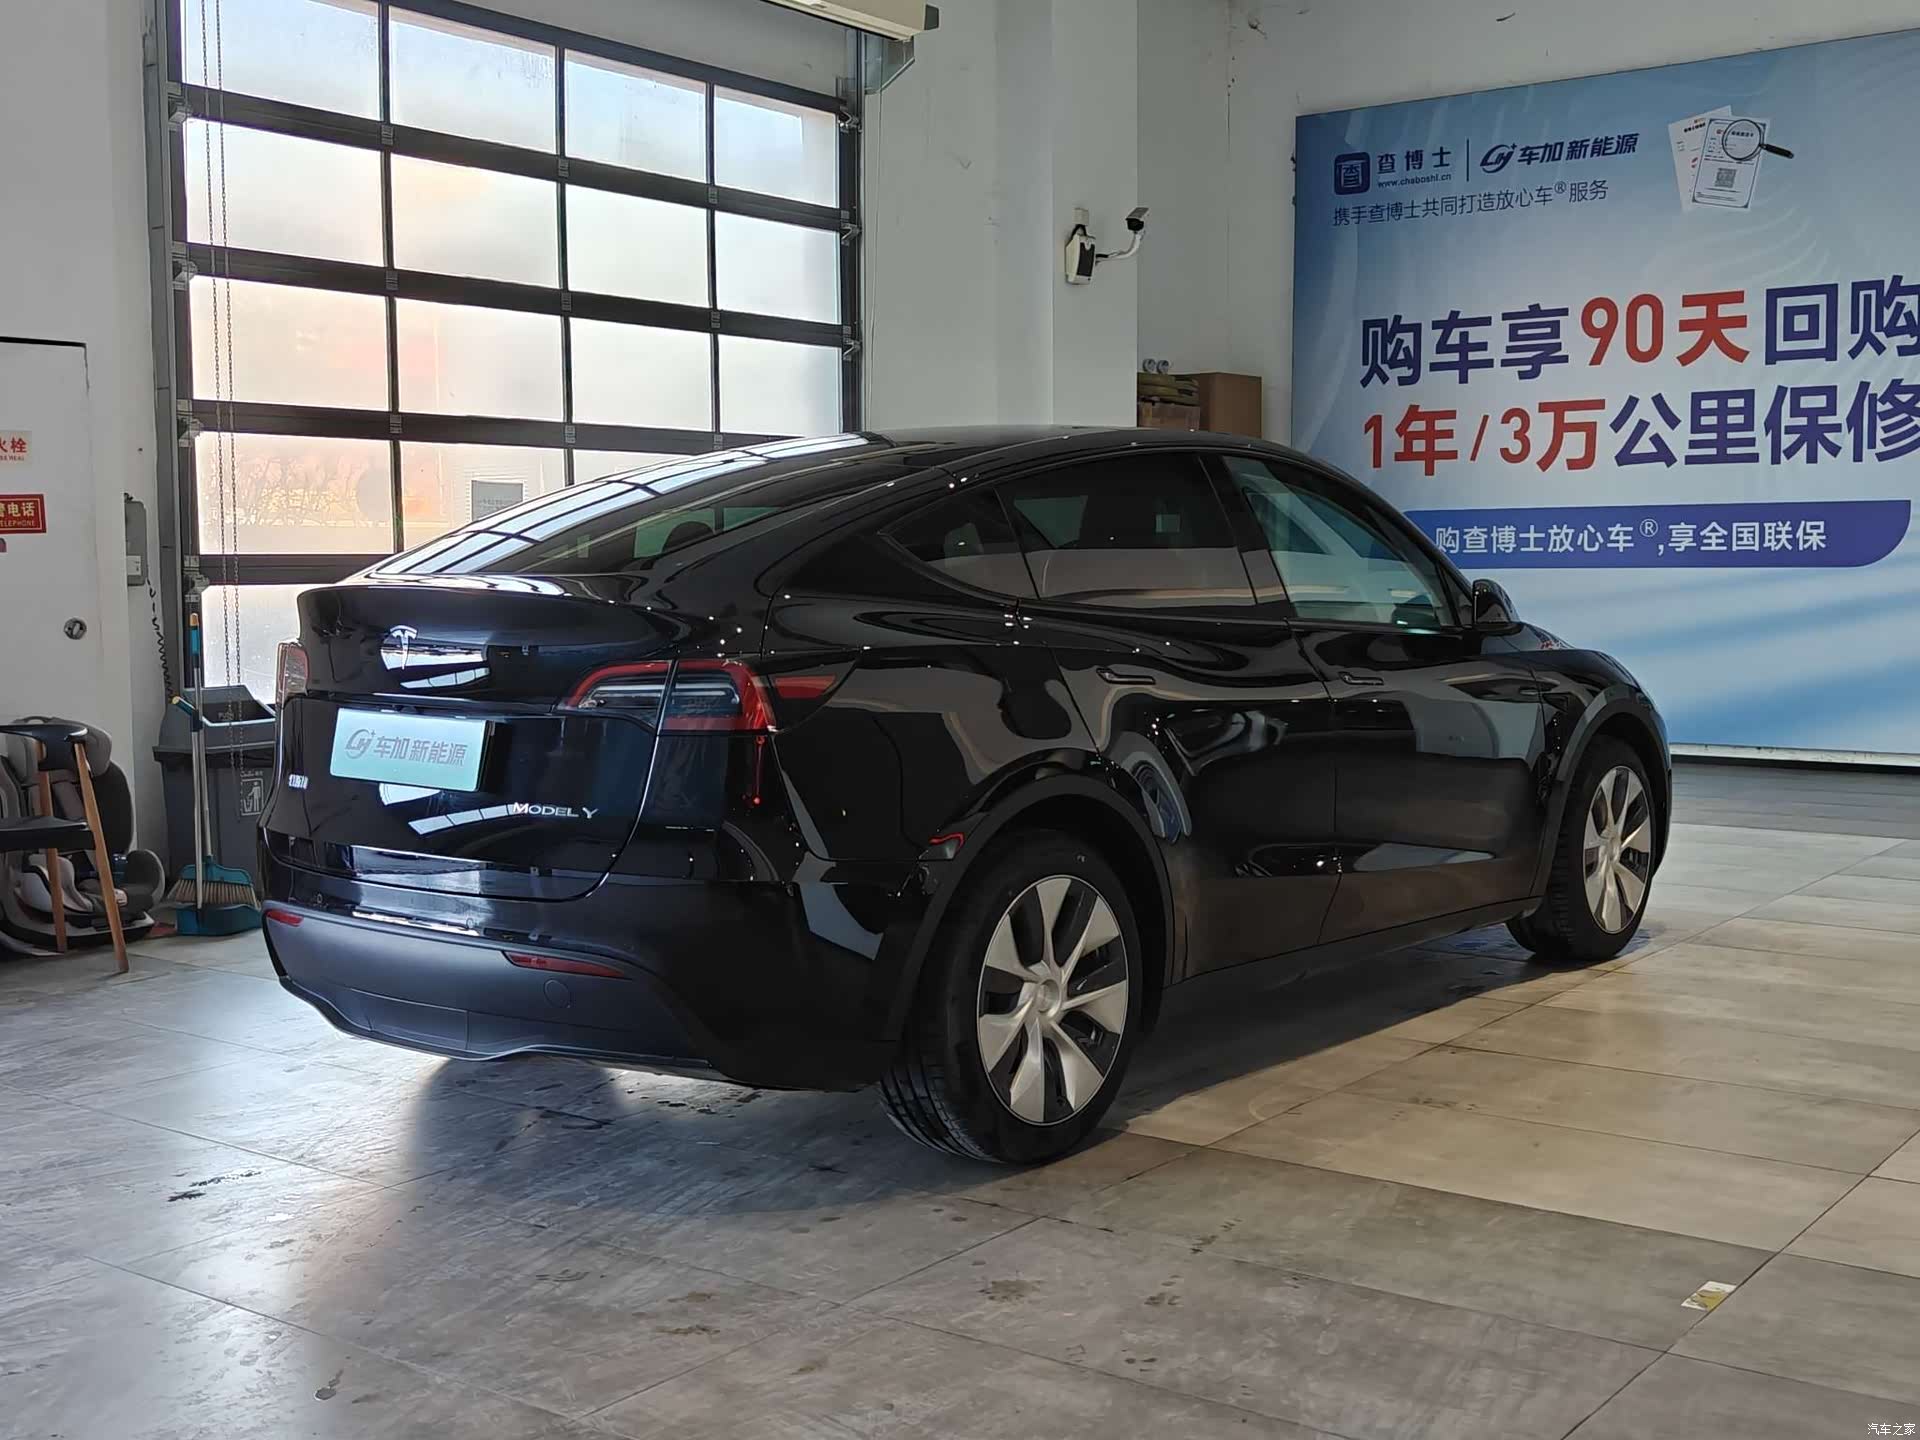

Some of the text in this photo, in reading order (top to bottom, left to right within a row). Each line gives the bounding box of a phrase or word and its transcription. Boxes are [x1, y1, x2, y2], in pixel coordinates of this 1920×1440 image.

[1377, 146, 1452, 175] 查博士
[1517, 132, 1640, 165] 车加新能源
[1359, 274, 1920, 389] 购车享90天回购
[1363, 378, 1920, 476] 1年/3万公里保修
[373, 735, 468, 766] 车加新能源
[513, 801, 599, 819] MODEL Y
